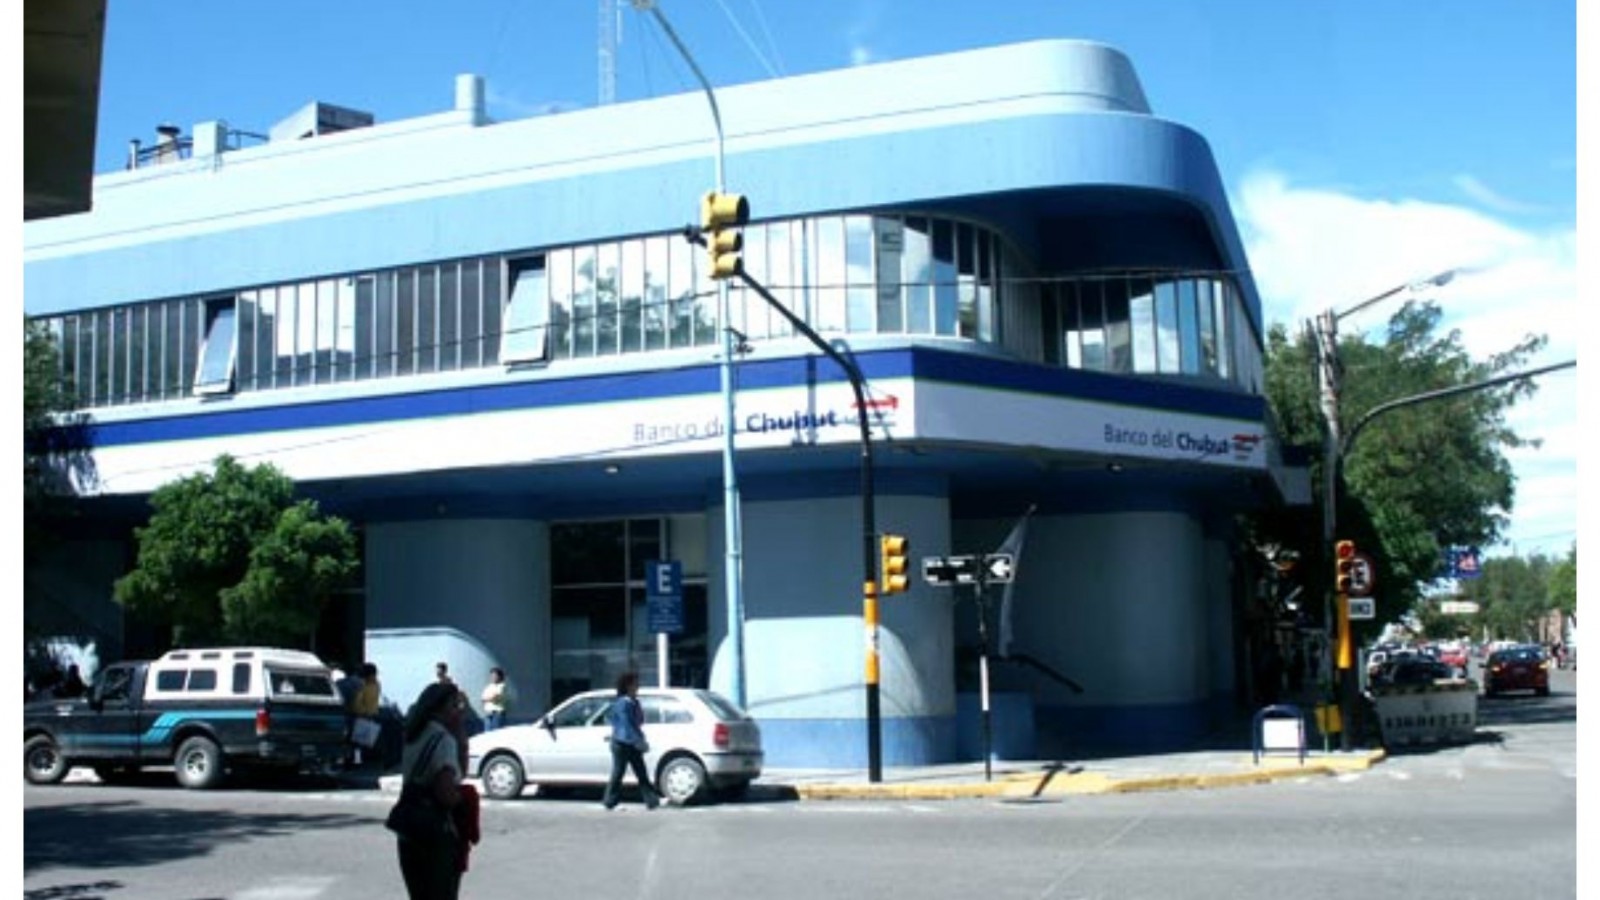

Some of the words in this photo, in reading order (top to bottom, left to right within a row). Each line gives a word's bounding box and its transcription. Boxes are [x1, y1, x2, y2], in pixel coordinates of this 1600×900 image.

[633, 421, 698, 441] Banco
[746, 410, 837, 433] Chubut
[1104, 424, 1148, 446] Banco
[1152, 431, 1174, 448] del
[1176, 432, 1229, 454] Chubut
[657, 563, 672, 593] E
